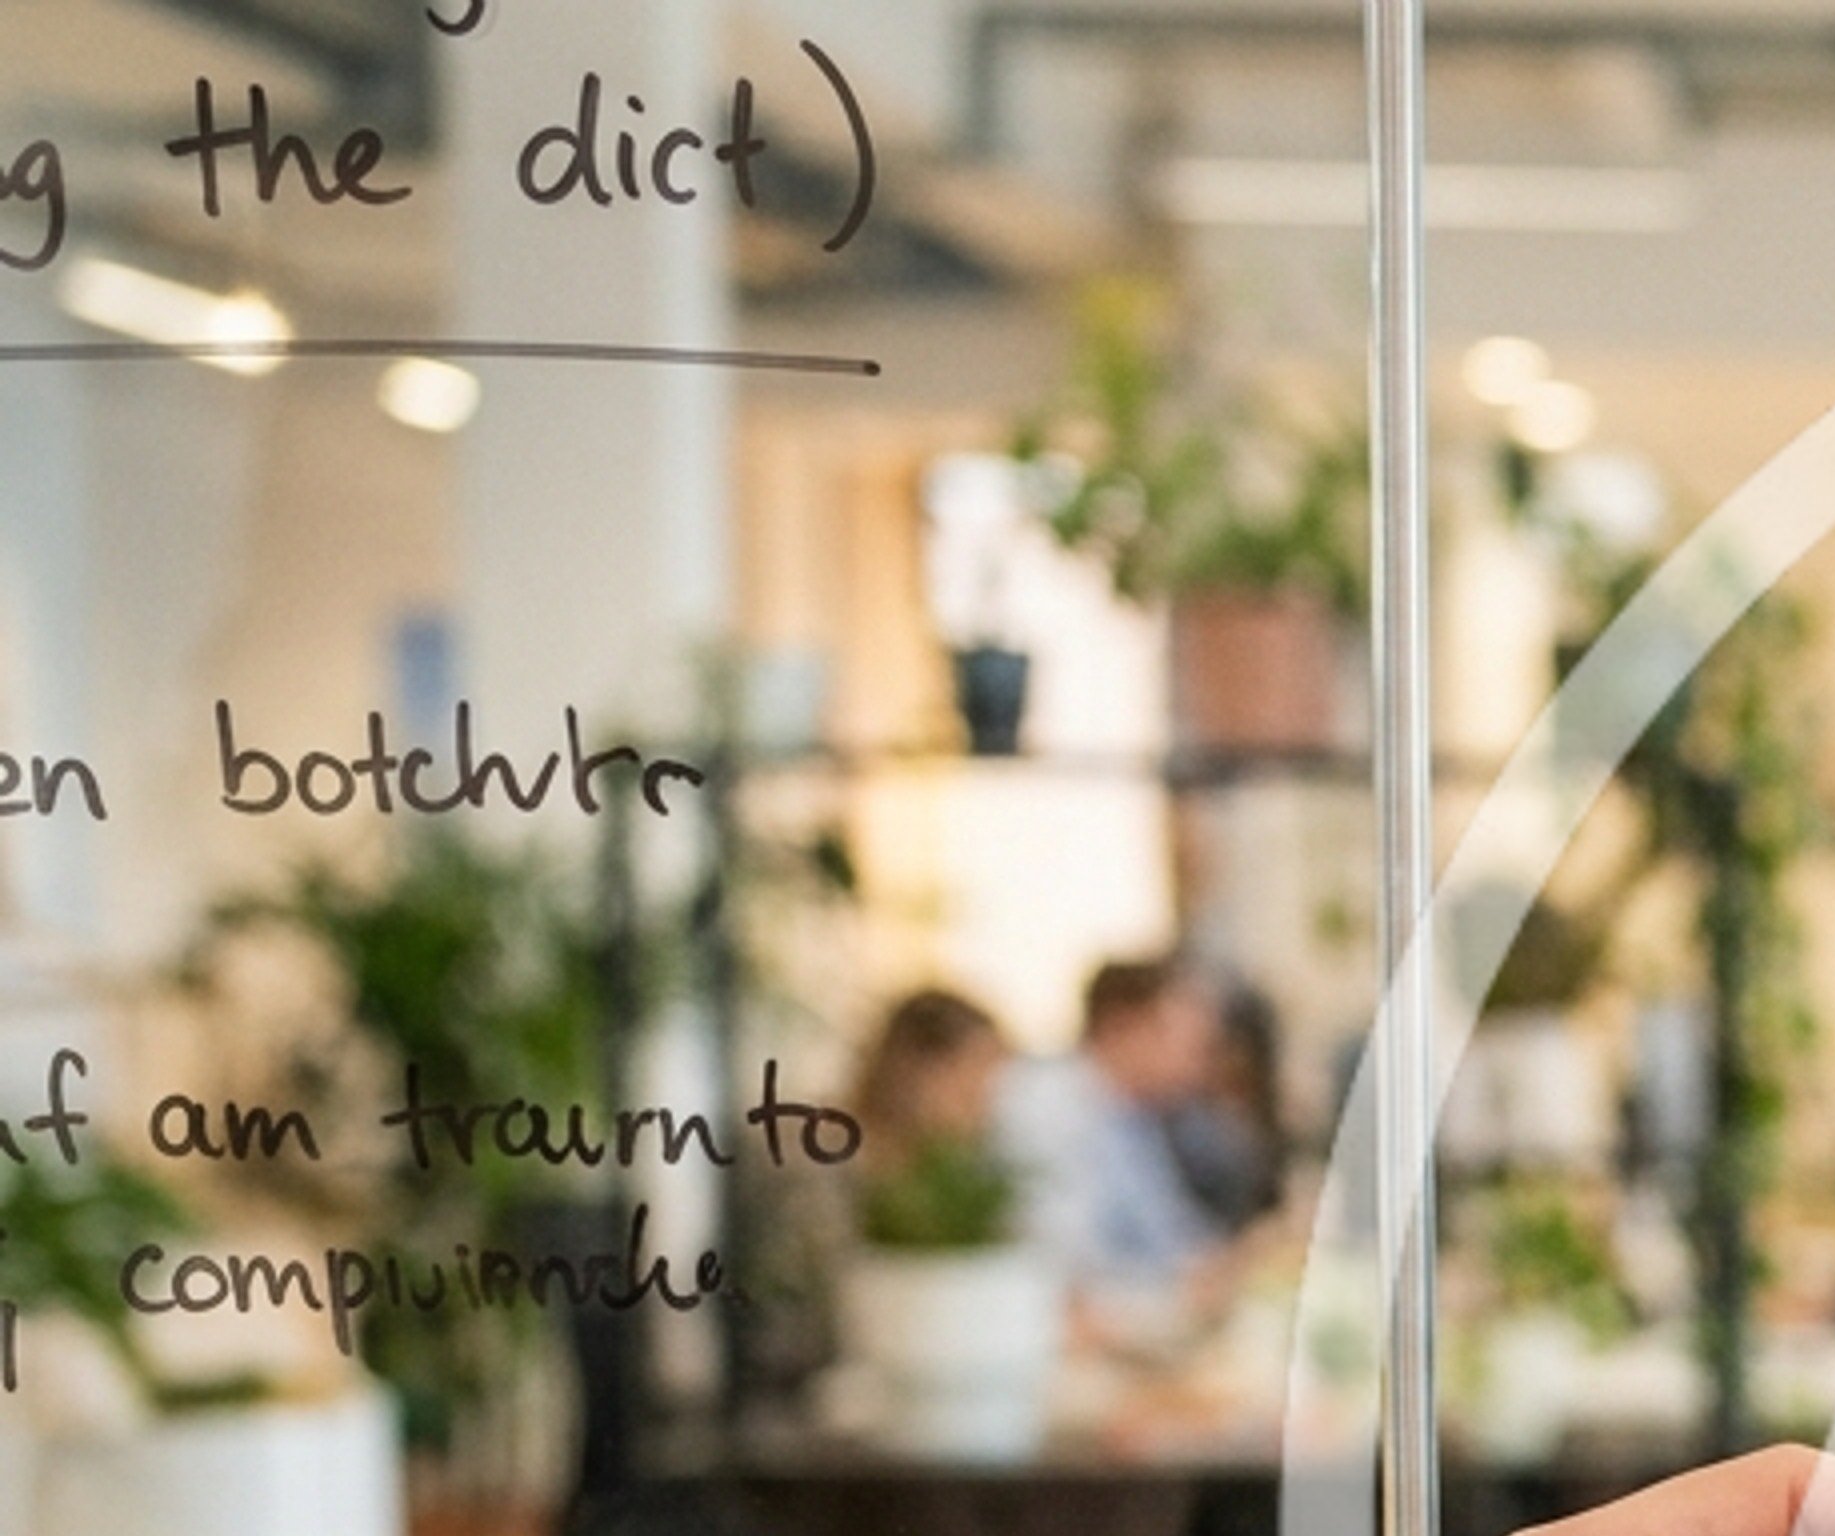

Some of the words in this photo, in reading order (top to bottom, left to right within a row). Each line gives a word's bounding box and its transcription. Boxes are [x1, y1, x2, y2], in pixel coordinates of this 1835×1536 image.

[165, 77, 412, 217] the
[517, 39, 876, 254] dict)
[150, 1094, 321, 1160] am
